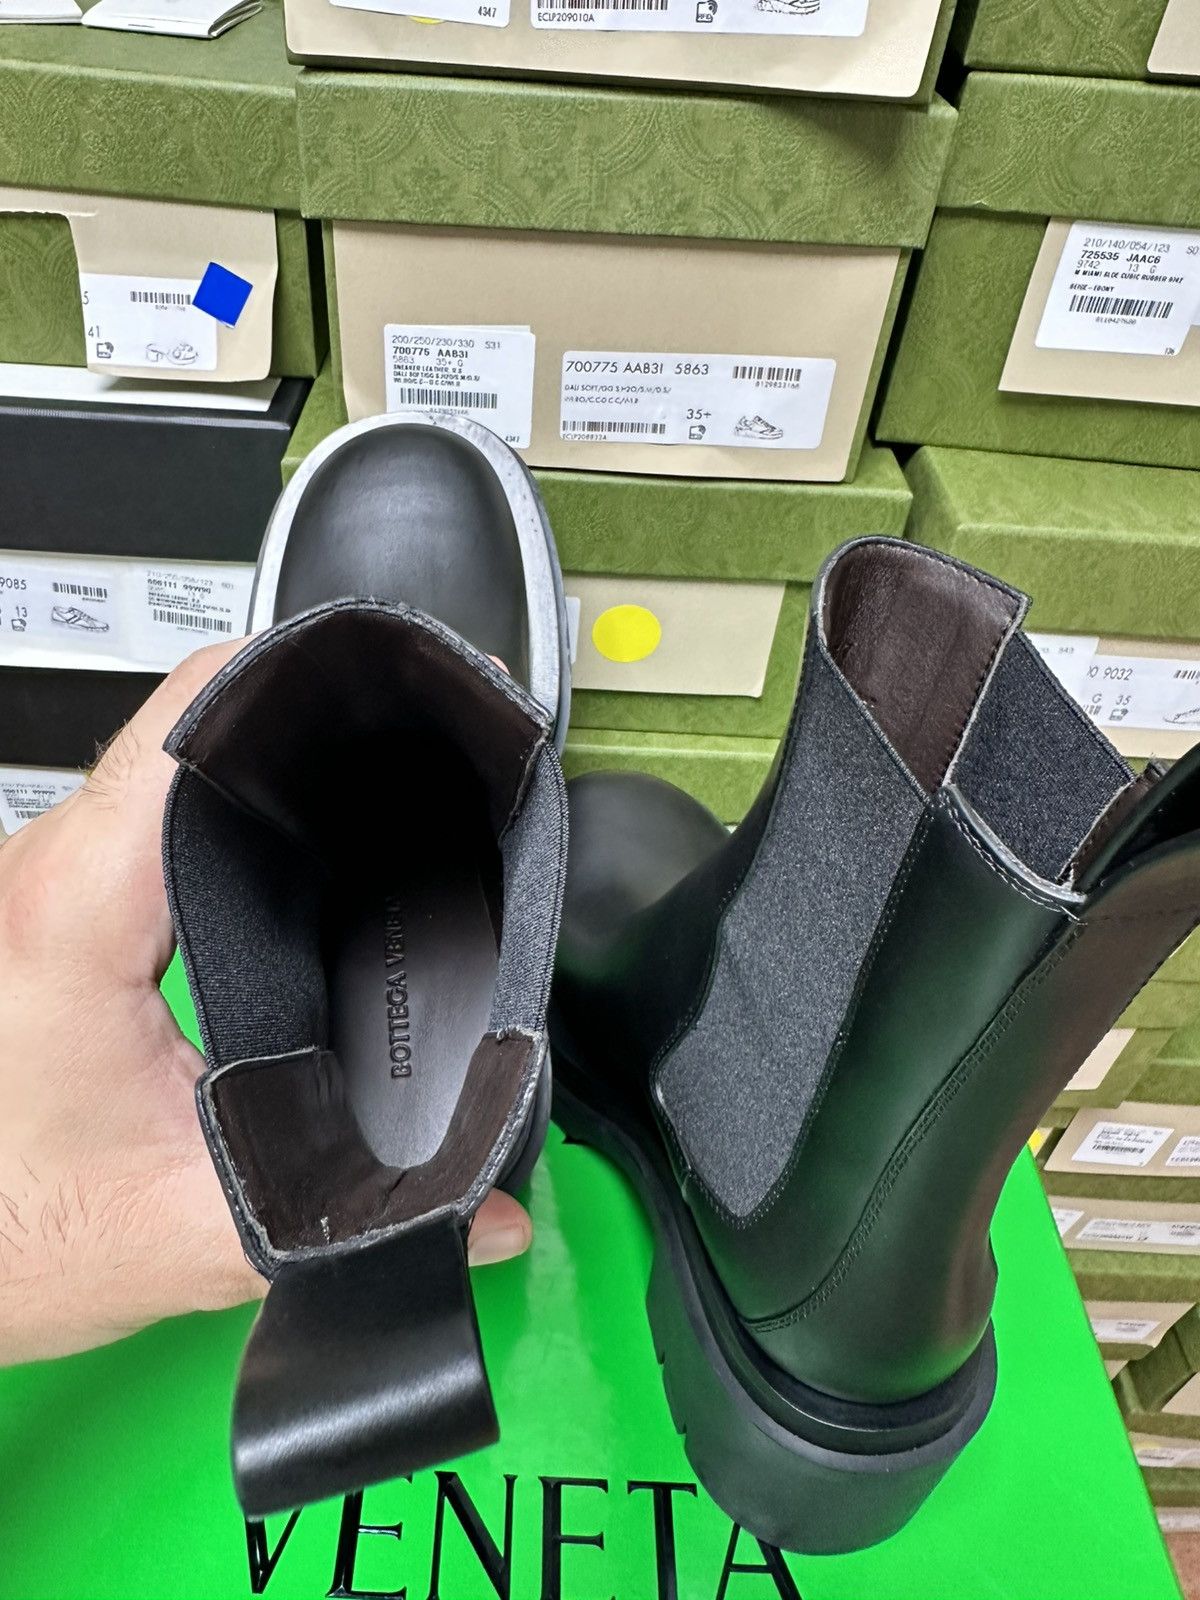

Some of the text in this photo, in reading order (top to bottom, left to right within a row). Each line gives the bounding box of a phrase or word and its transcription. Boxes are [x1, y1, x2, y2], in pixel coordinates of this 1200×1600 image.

[478, 6, 497, 18] 4347
[538, 12, 596, 22] ECLP209010A
[1081, 250, 1162, 265] 725535 JAAC6
[88, 326, 100, 338] 41
[392, 335, 476, 348] 200/250/230/330
[393, 346, 430, 357] 700775
[565, 360, 619, 374] 700775
[674, 364, 710, 376] 5863
[686, 407, 712, 420] 35+
[0, 576, 27, 590] 9085
[16, 605, 28, 619] 13
[1103, 665, 1134, 681] 9032
[1091, 692, 1133, 706] G 35
[385, 970, 413, 1079] BOTTEGA
[243, 1471, 803, 1600] VENETA
